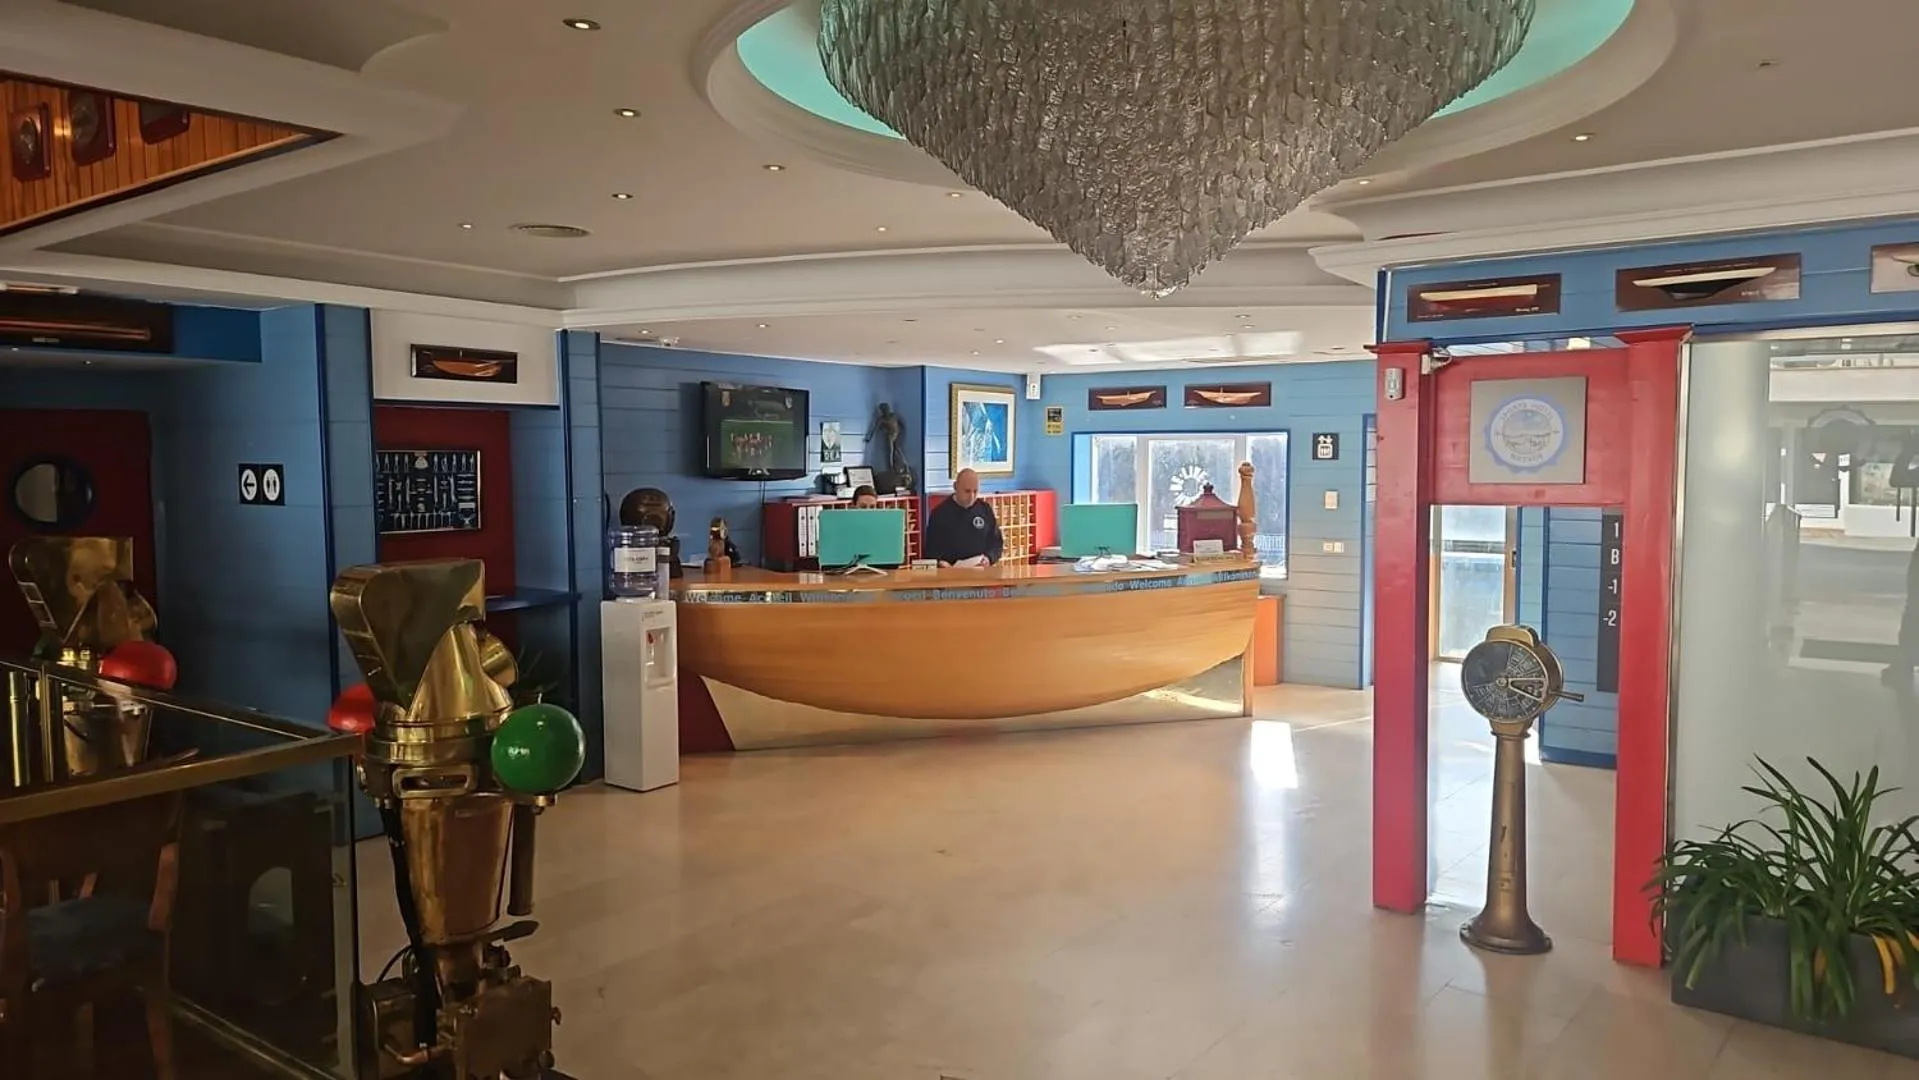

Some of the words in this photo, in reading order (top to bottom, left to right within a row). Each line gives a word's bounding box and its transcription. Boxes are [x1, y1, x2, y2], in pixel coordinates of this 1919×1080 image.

[1613, 522, 1619, 539] 1
[1611, 549, 1620, 565] B
[1608, 579, 1618, 594] -1
[1603, 610, 1617, 626] -2
